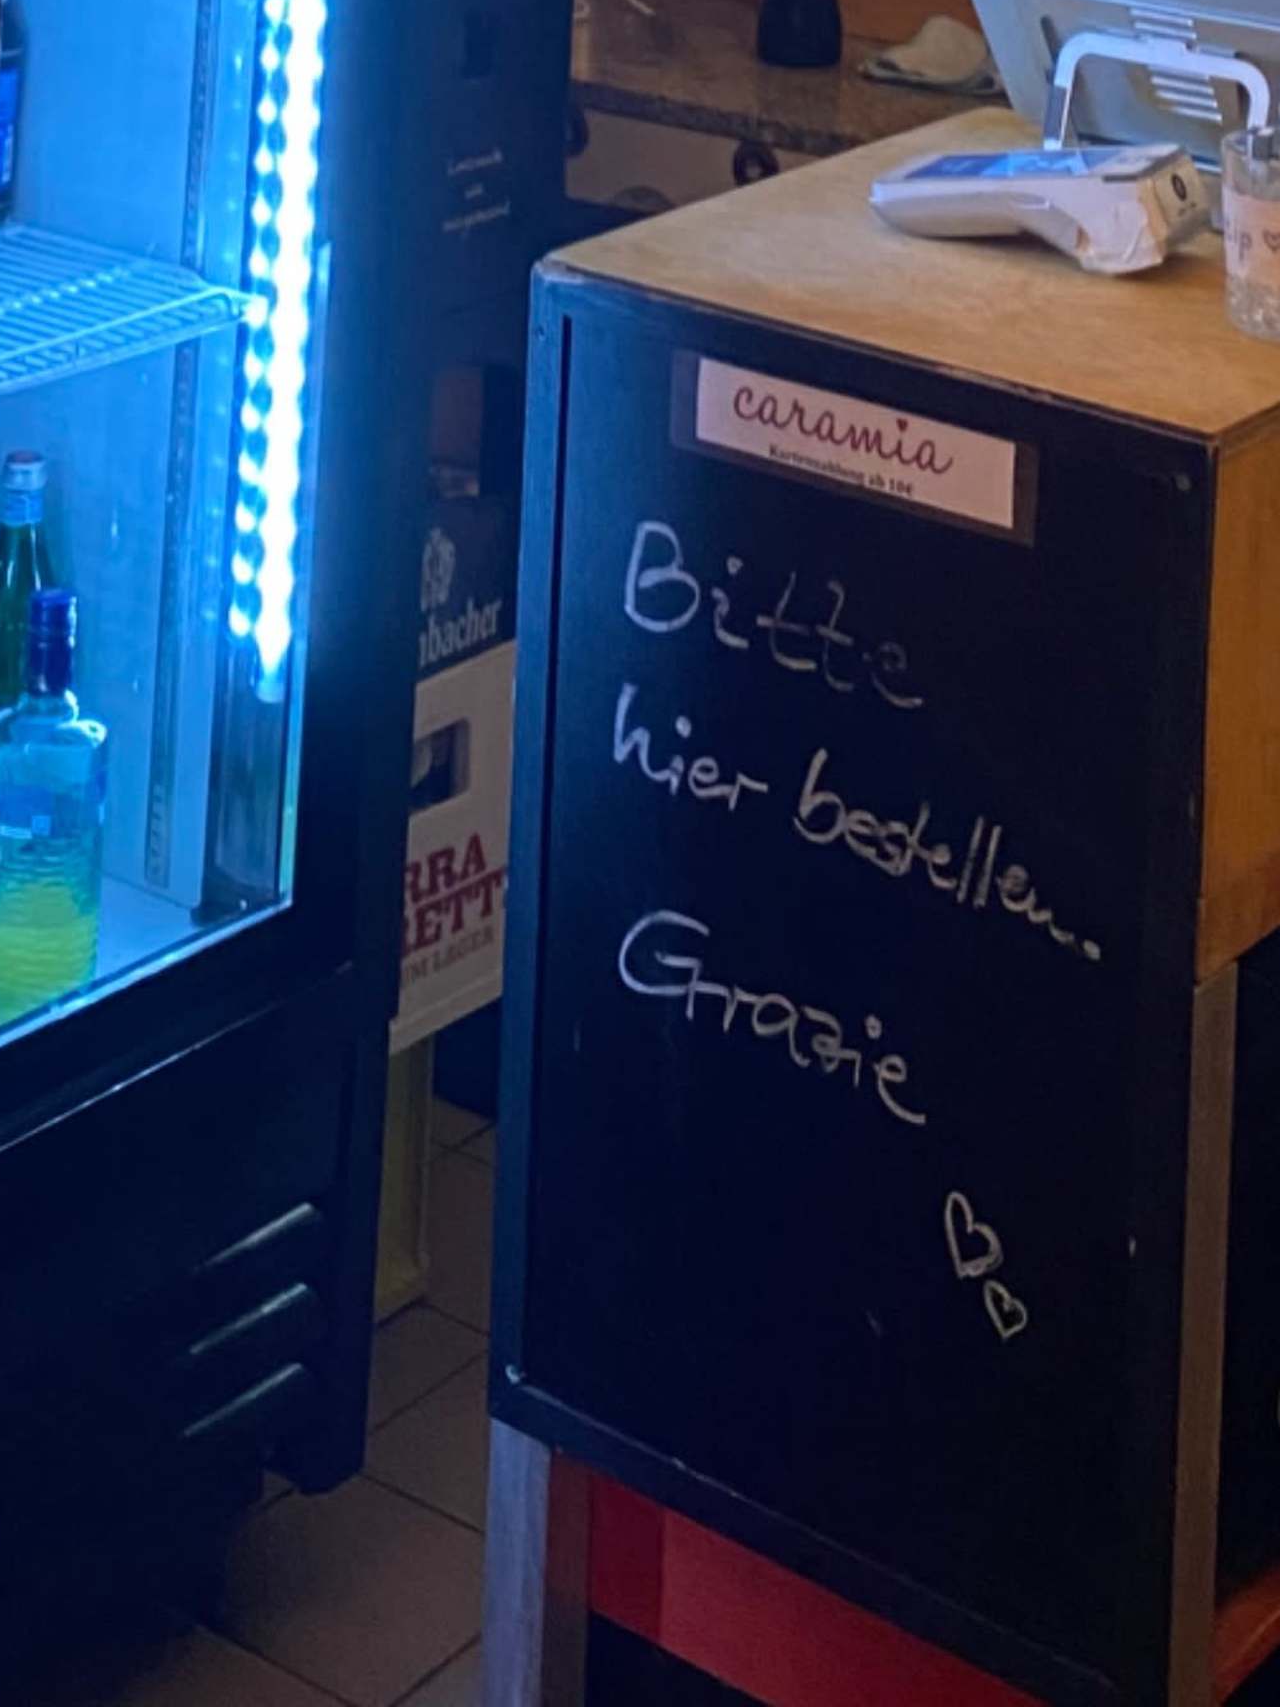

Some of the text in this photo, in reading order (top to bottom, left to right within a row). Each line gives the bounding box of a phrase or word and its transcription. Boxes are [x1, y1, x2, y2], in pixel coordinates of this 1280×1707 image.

[733, 385, 954, 475] caramia
[624, 521, 923, 707] Bitte
[615, 684, 769, 810] hier
[618, 910, 926, 1126] Grazie
